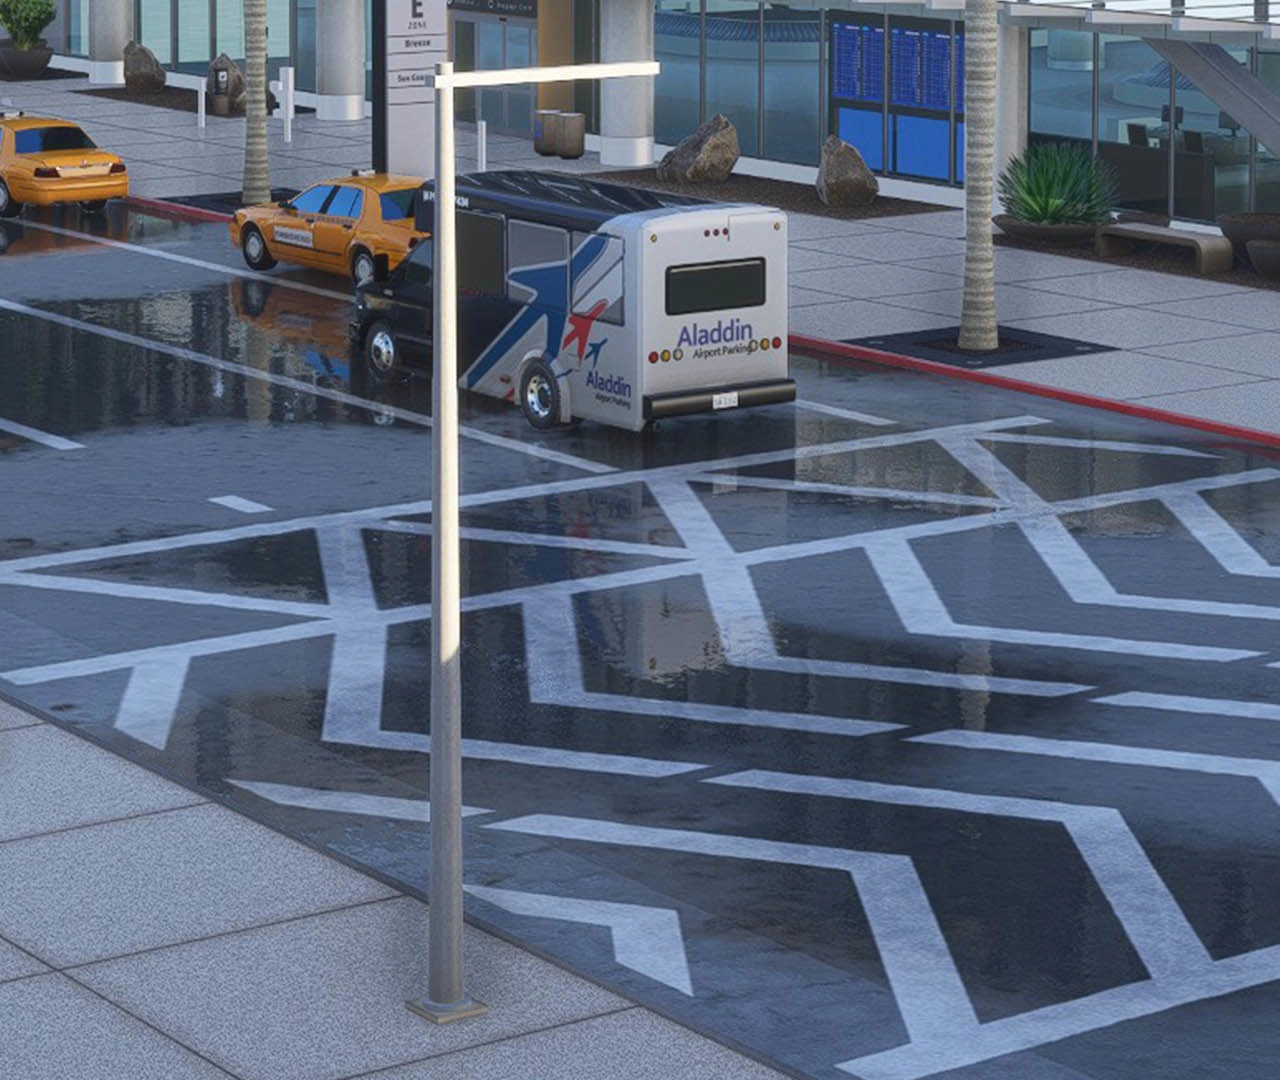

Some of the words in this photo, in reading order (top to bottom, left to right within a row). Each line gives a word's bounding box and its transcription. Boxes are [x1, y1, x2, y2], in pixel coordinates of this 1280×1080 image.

[677, 318, 752, 347] Aladdin
[692, 347, 721, 360] Airport
[585, 370, 631, 398] Aladdin
